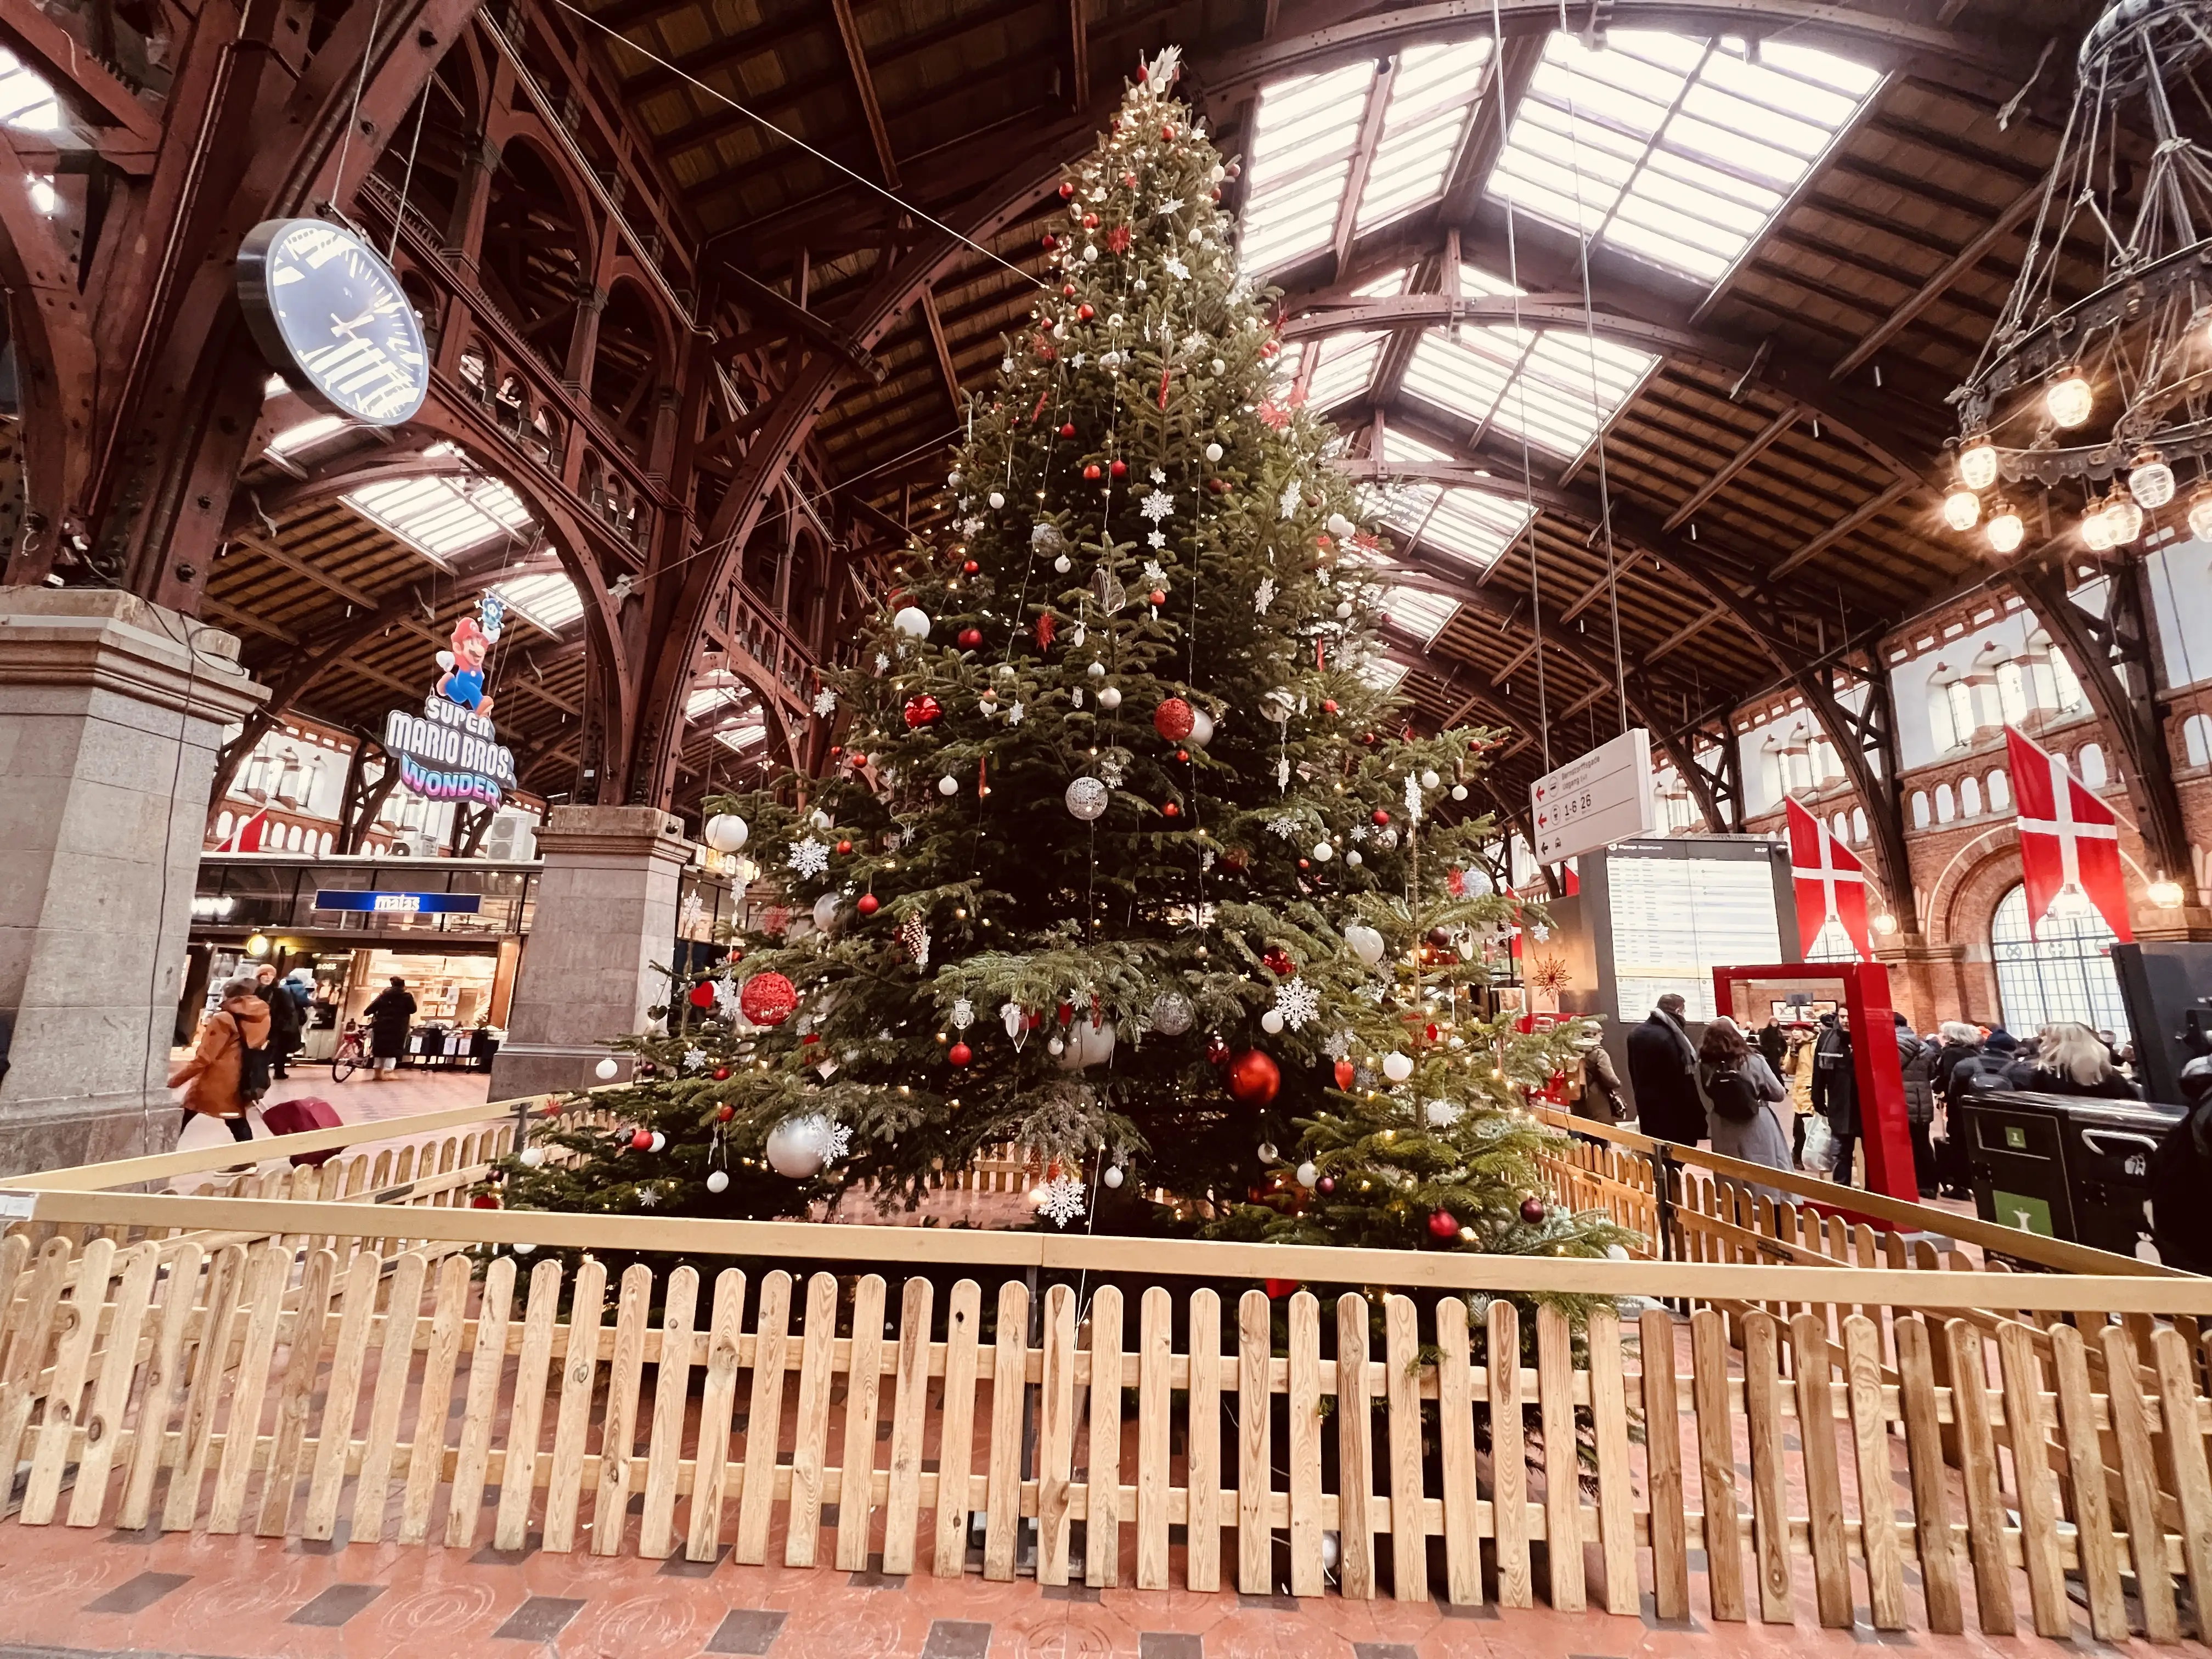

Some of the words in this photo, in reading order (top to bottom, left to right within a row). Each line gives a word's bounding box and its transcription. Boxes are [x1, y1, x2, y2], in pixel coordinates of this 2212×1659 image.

[427, 698, 490, 737] SUPER
[387, 713, 459, 764] MARIO
[460, 737, 512, 781] BROS.
[402, 753, 498, 805] WONDER
[1565, 800, 1577, 816] 1-6
[1580, 794, 1591, 809] 26
[375, 894, 420, 911] matas
